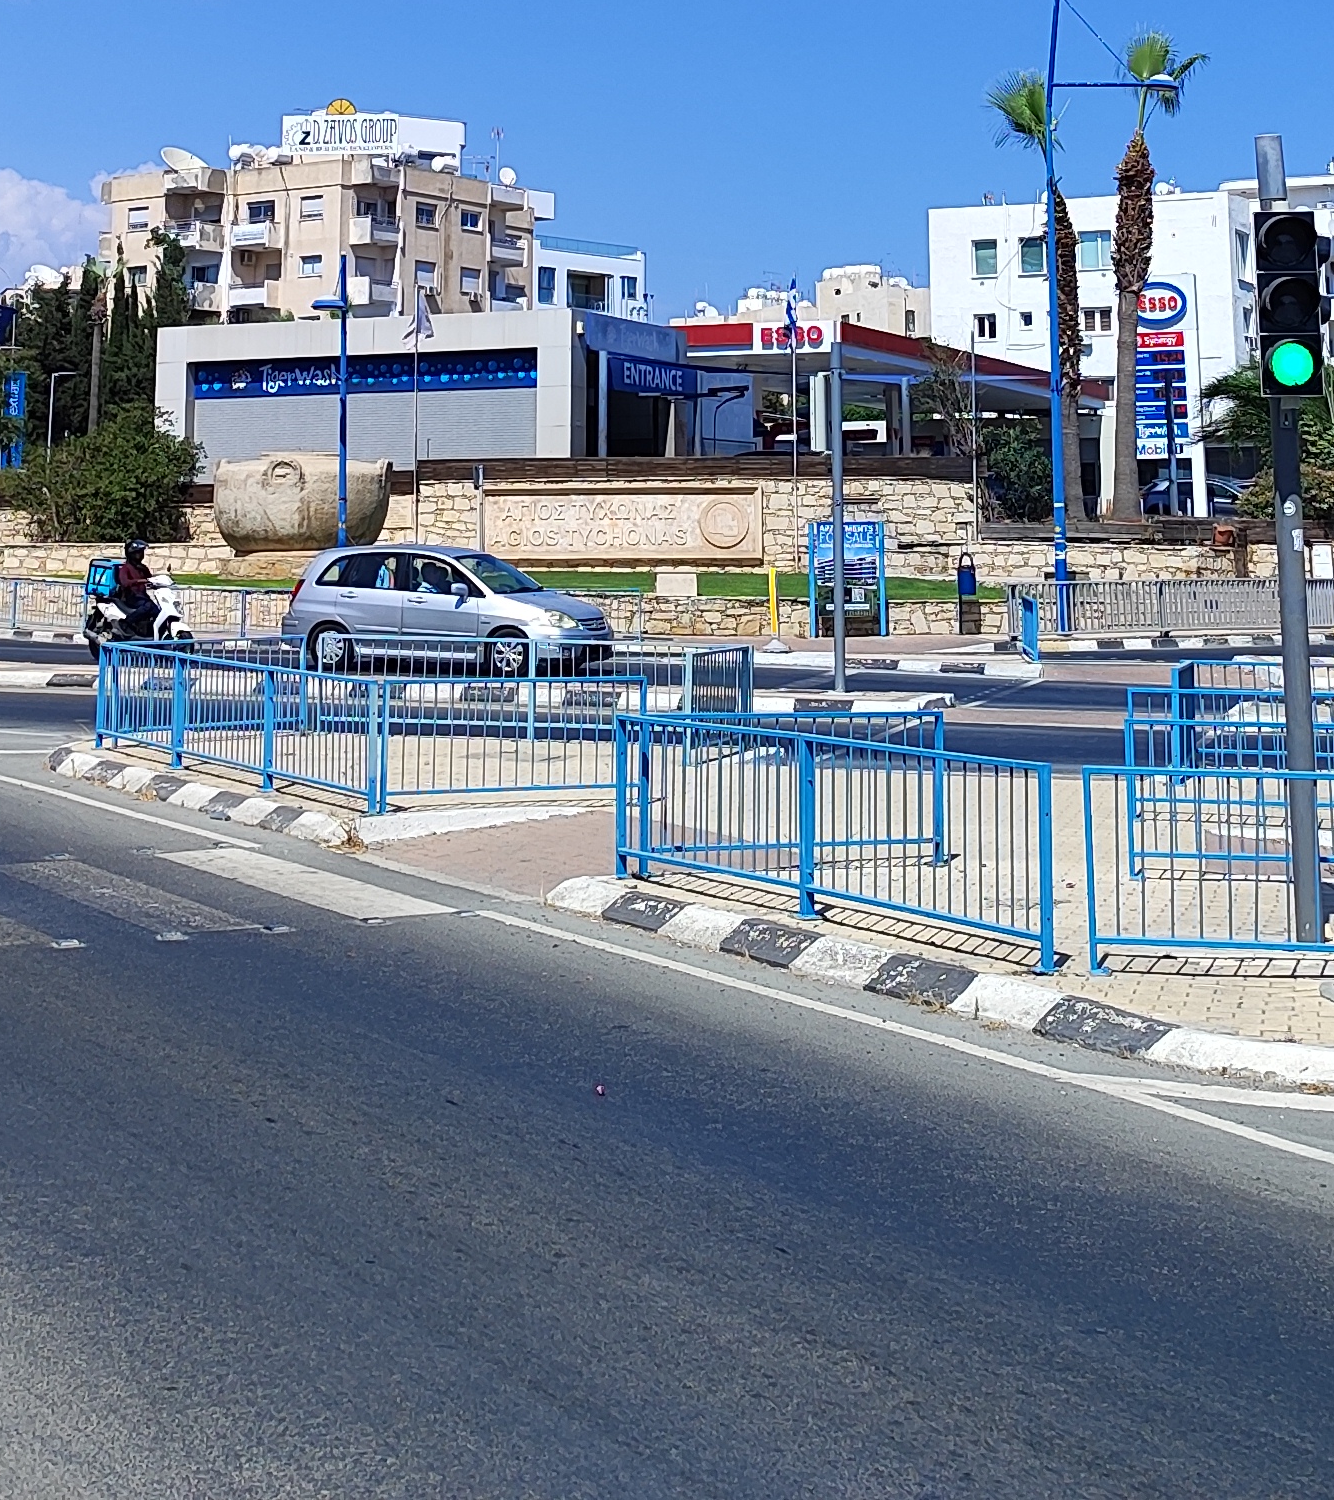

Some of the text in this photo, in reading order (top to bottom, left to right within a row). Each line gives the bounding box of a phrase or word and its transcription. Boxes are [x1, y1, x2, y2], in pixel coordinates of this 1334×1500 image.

[323, 119, 358, 145] ZAVOS
[360, 118, 397, 144] GROUP
[1143, 335, 1178, 347] Synergy
[623, 361, 683, 392] ENTRANCE
[501, 501, 677, 522] ΑΓΙΟΣ ΤΥΧΩΝΑΣ
[489, 528, 689, 547] AGIOS TYCHONAS
[845, 532, 874, 544] SALE
